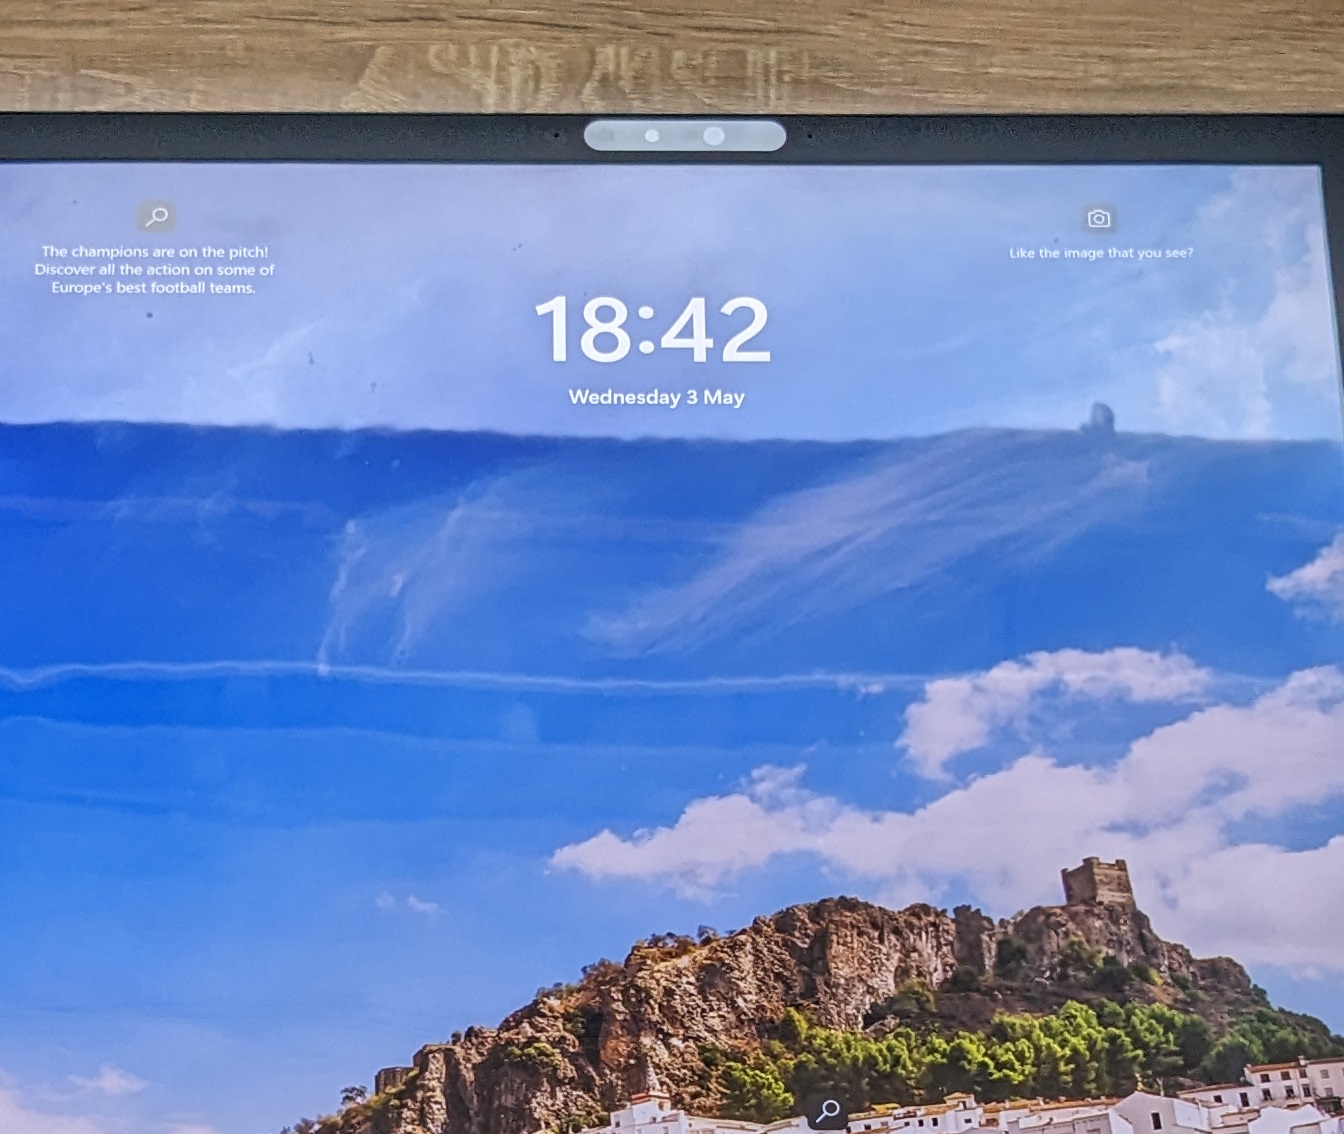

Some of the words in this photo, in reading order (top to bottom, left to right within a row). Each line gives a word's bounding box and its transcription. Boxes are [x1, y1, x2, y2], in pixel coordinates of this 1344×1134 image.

[42, 245, 67, 258] The
[72, 245, 148, 260] champions
[153, 248, 175, 258] are
[179, 248, 197, 258] on
[202, 246, 225, 258] the
[230, 246, 269, 260] pitch!
[1010, 249, 1035, 258] Like
[1040, 249, 1059, 259] the
[1064, 249, 1103, 261] image
[1108, 249, 1134, 258] that
[1138, 250, 1161, 260] you
[1165, 249, 1193, 258] see?
[35, 263, 95, 276] Discover
[99, 264, 115, 276] all
[120, 264, 142, 276] the
[147, 264, 190, 276] action
[194, 266, 212, 276] on
[217, 266, 255, 276] some
[259, 264, 275, 276] of
[52, 281, 112, 296] Europe's
[117, 282, 147, 294] best
[151, 282, 205, 294] football
[210, 283, 255, 294] teams.
[535, 296, 770, 363] 18:42
[569, 389, 681, 409] Wednesday
[687, 389, 698, 405] 3
[705, 389, 745, 409] May
